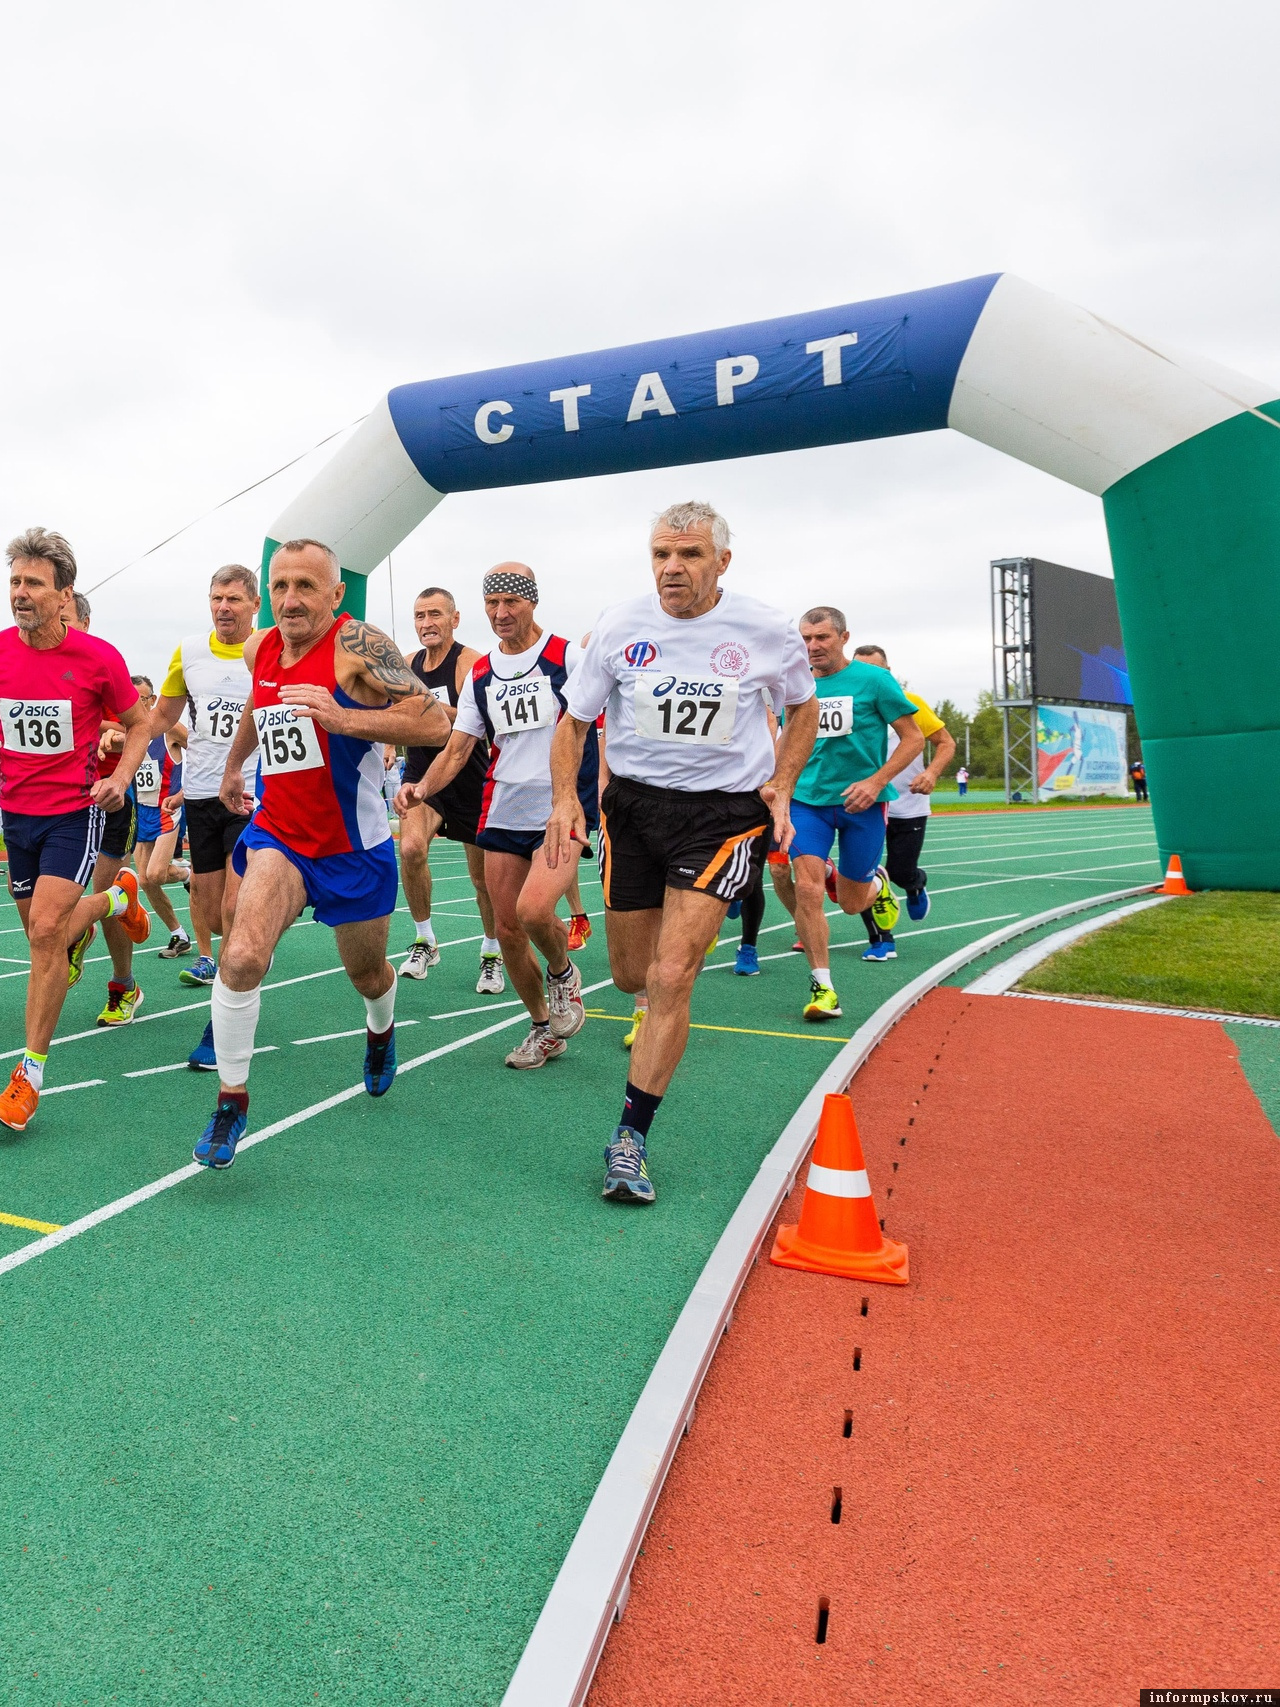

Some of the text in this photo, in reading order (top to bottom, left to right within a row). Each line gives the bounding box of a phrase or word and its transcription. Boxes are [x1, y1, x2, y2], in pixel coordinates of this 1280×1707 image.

[474, 332, 858, 445] СТАРТ
[509, 681, 540, 696] asics
[675, 682, 724, 697] asics
[25, 706, 60, 717] asics
[221, 701, 245, 713] asic
[501, 695, 539, 726] 141
[658, 699, 721, 736] 127
[210, 712, 240, 738] 13
[819, 710, 842, 732] 40
[14, 719, 62, 748] 136
[262, 726, 307, 766] 153
[136, 771, 154, 788] 38
